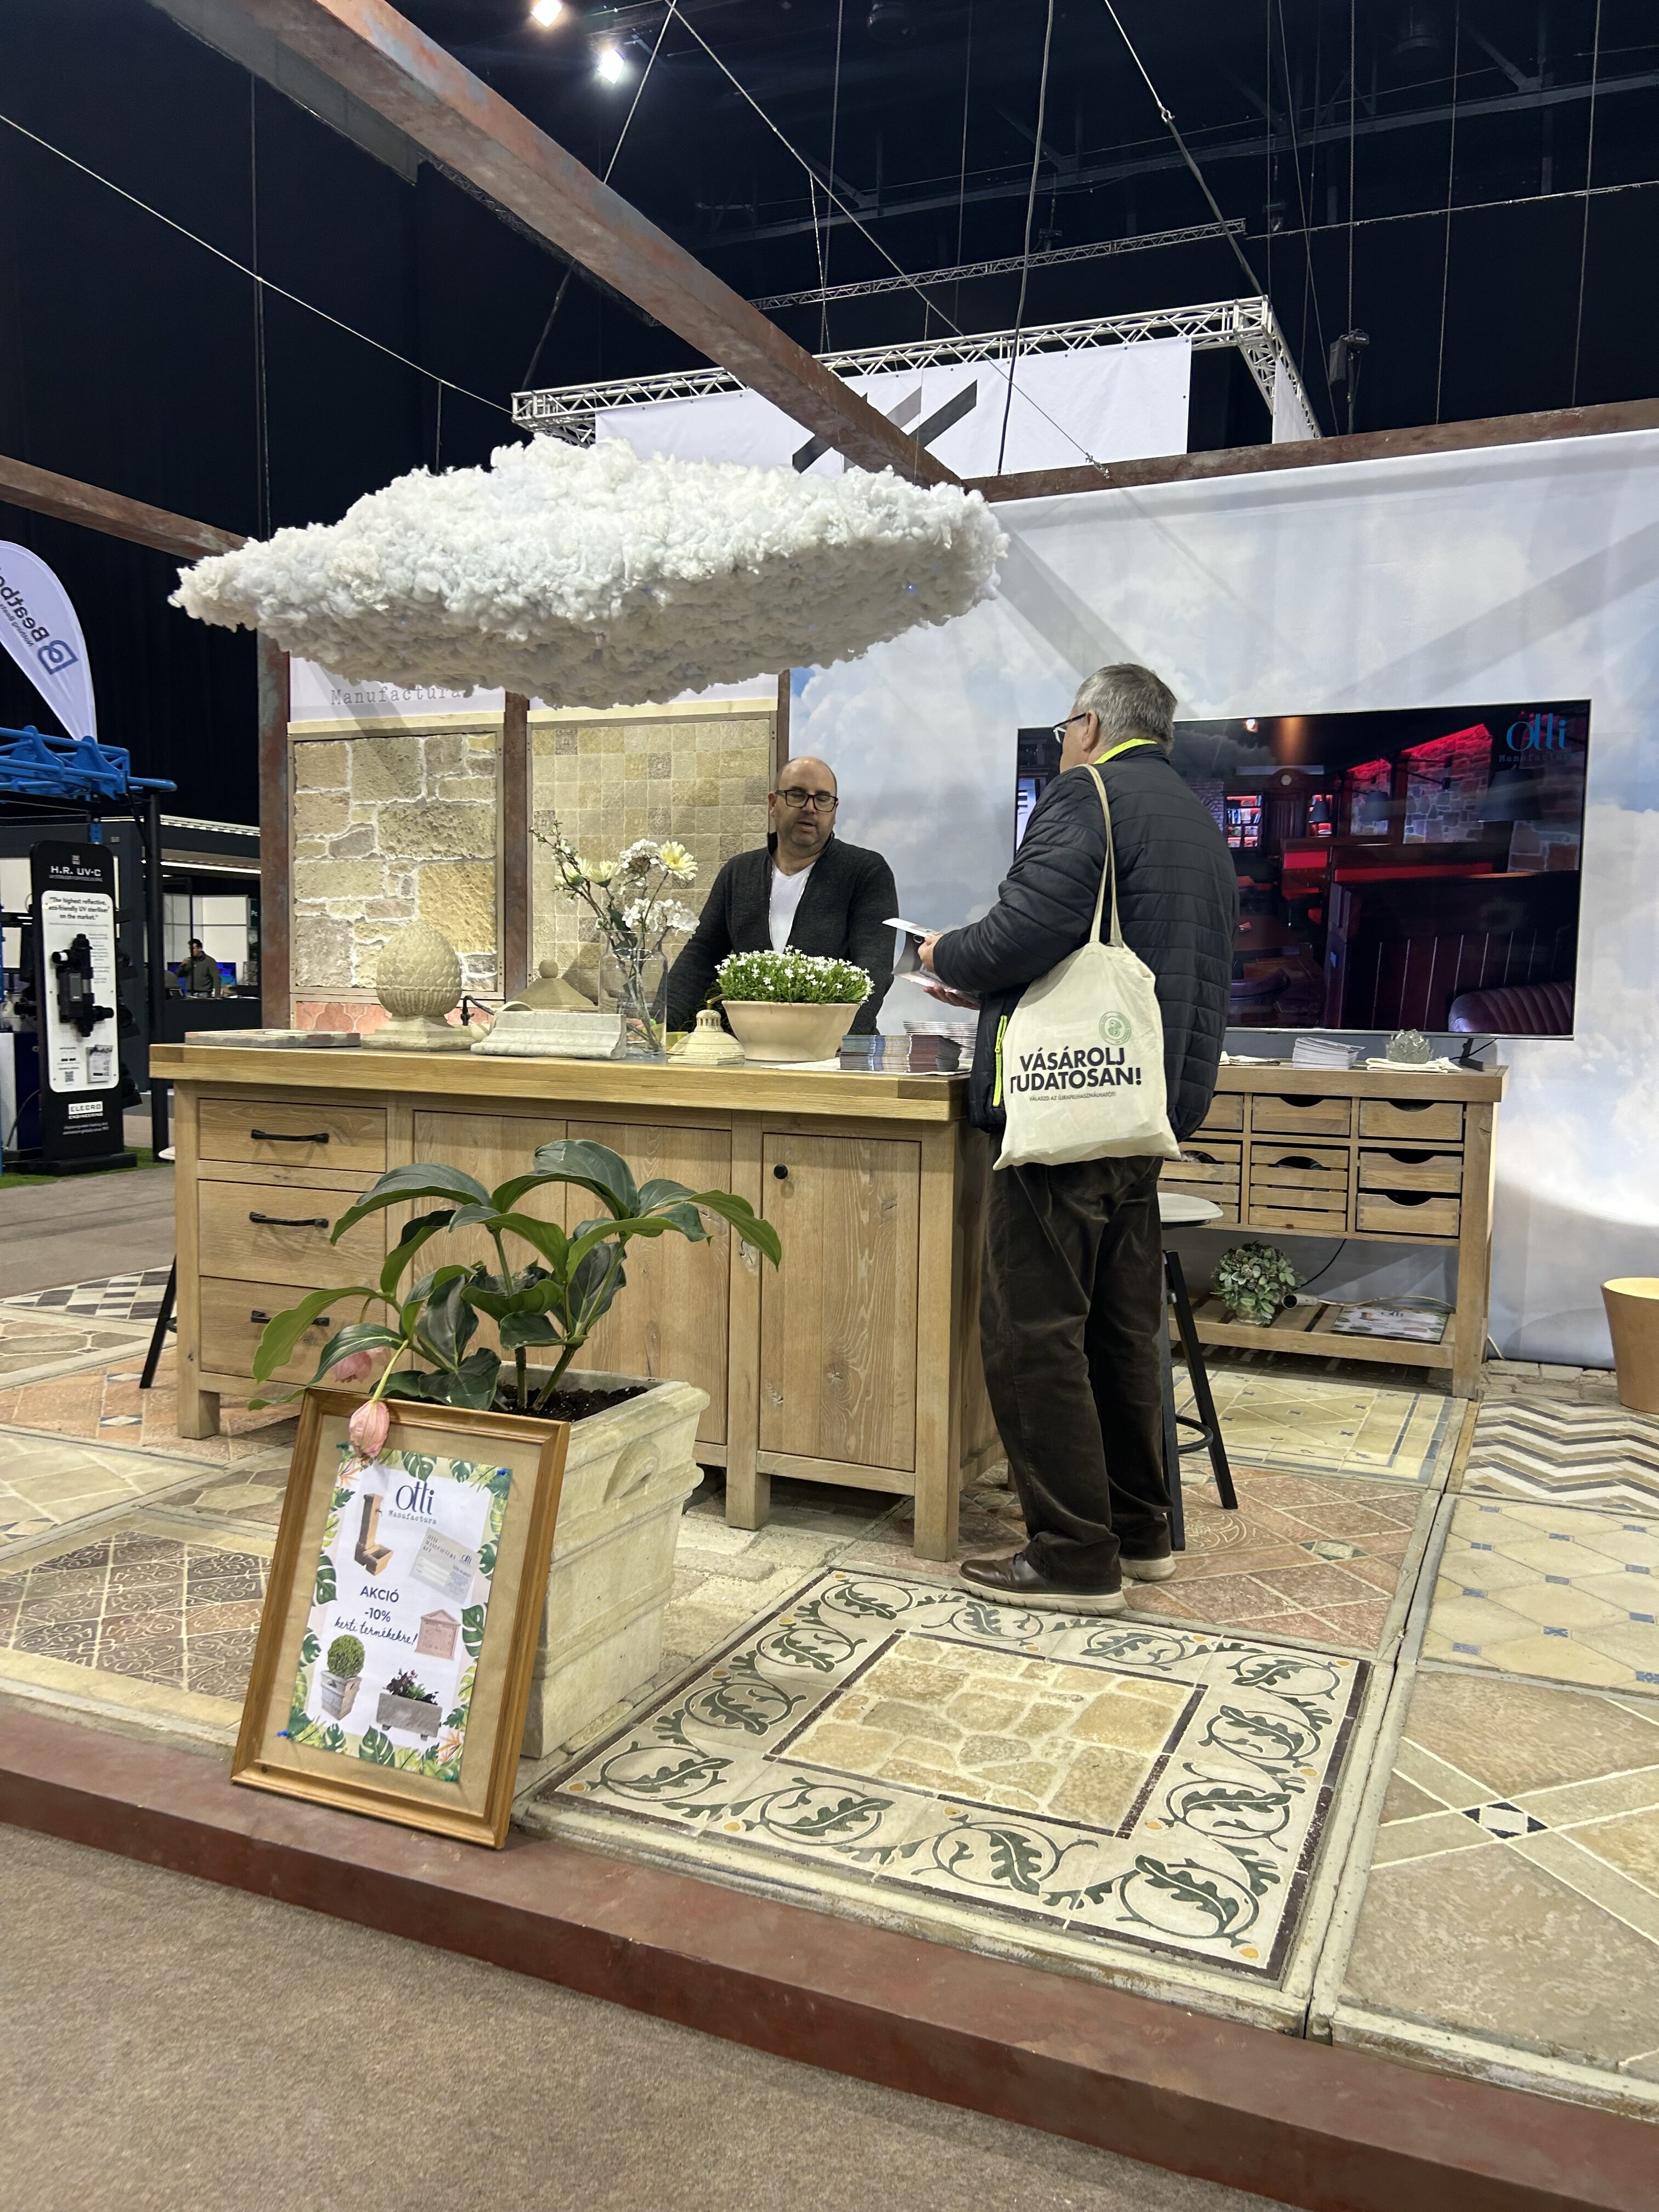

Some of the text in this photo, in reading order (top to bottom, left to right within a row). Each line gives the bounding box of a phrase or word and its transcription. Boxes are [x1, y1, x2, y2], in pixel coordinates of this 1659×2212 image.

[50, 866, 101, 877] H.R. UV-C
[1019, 1045, 1125, 1072] VÁSÁROLJ
[360, 1585, 399, 1602] AKCIÓ
[364, 1607, 391, 1622] -10%
